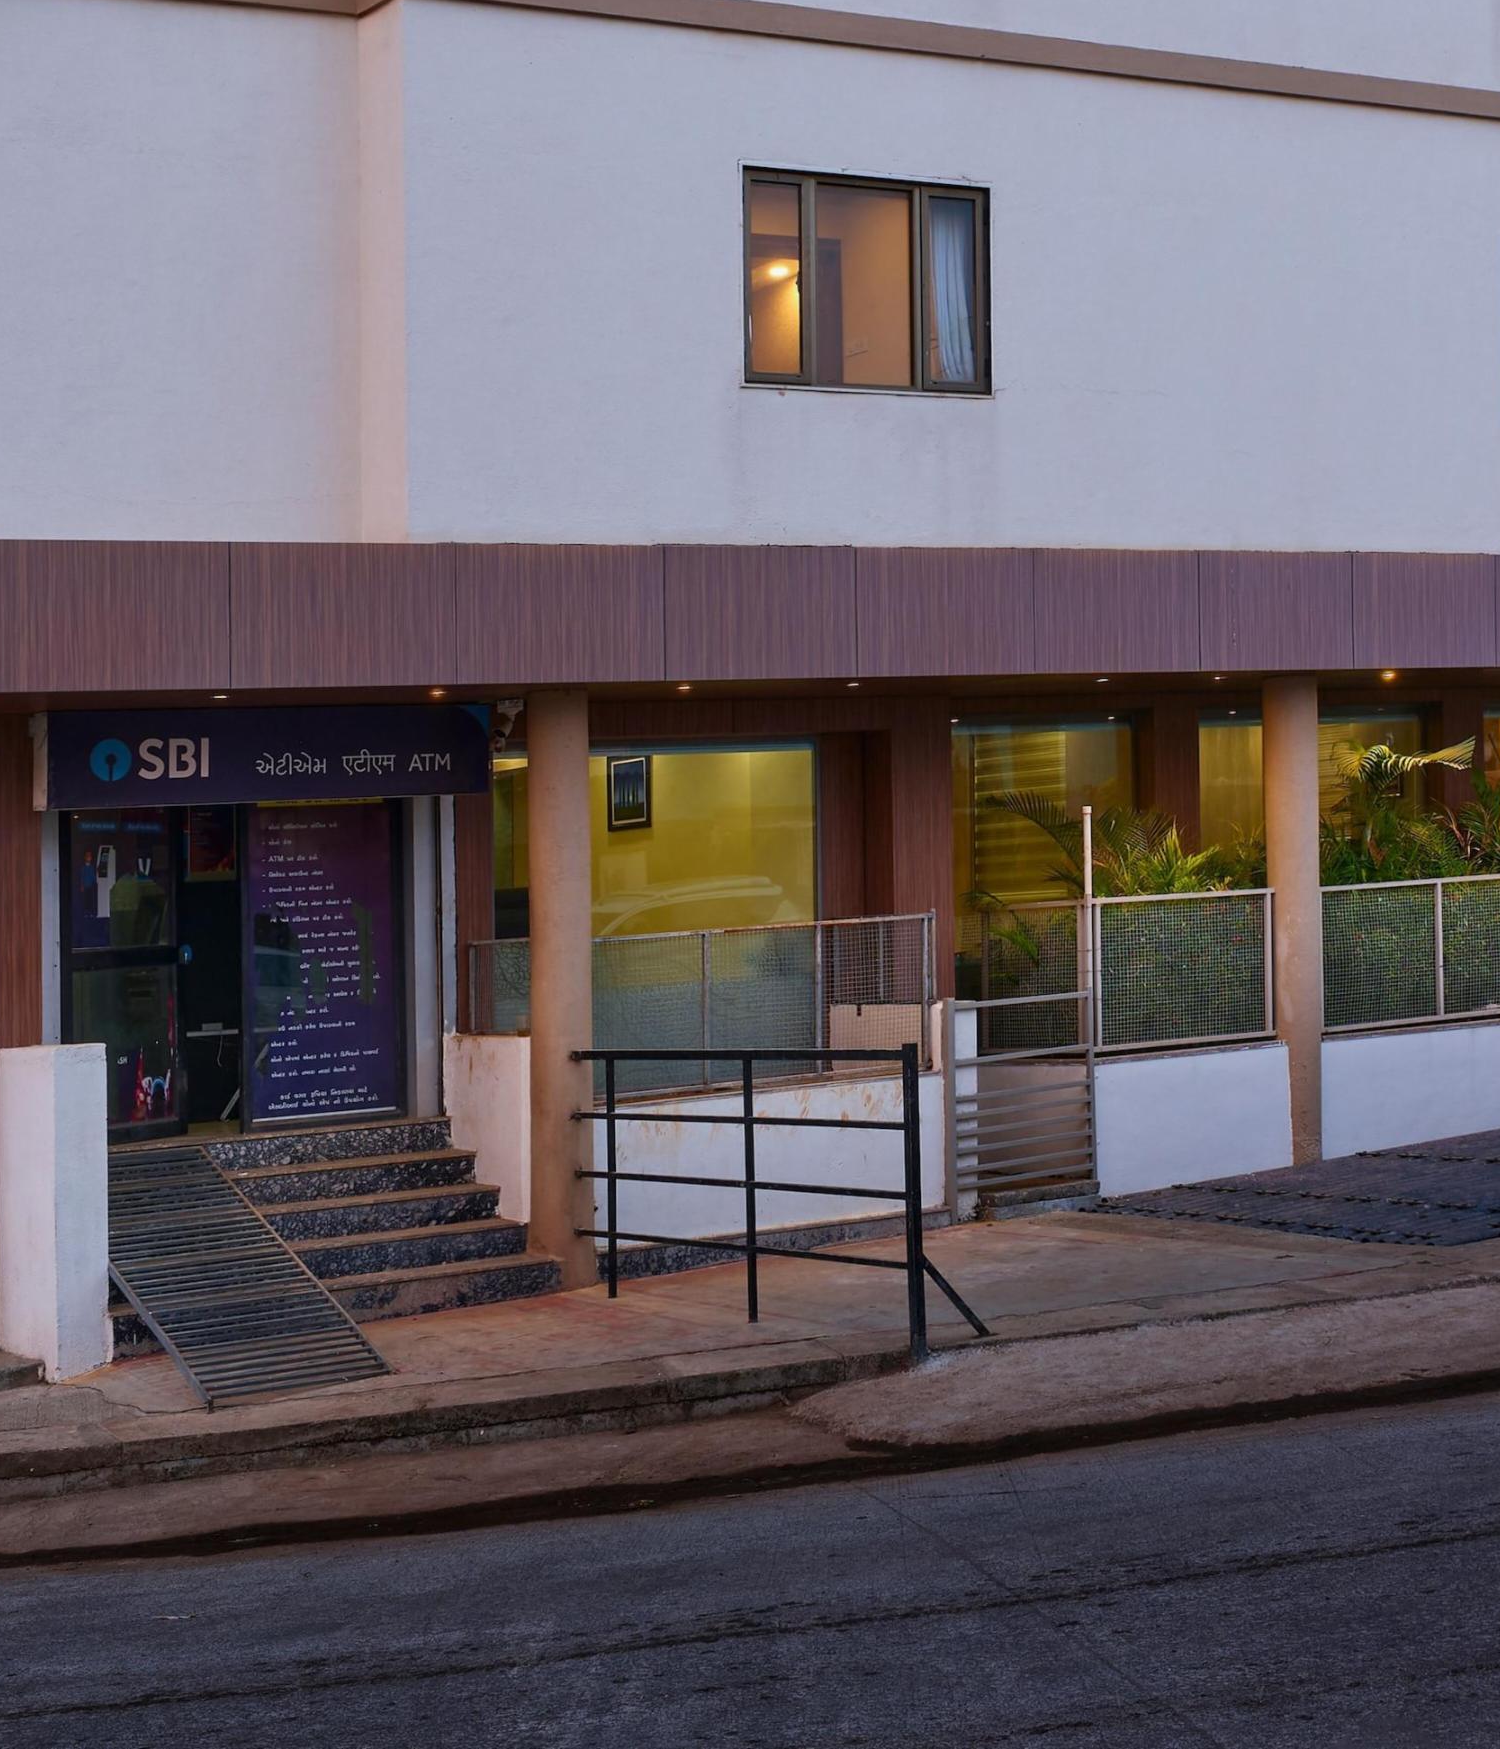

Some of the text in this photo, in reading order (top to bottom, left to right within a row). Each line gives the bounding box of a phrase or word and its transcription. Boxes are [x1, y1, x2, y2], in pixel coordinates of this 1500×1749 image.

[137, 737, 211, 781] SBI
[254, 748, 451, 776] એટીએમ एटीएम ATM
